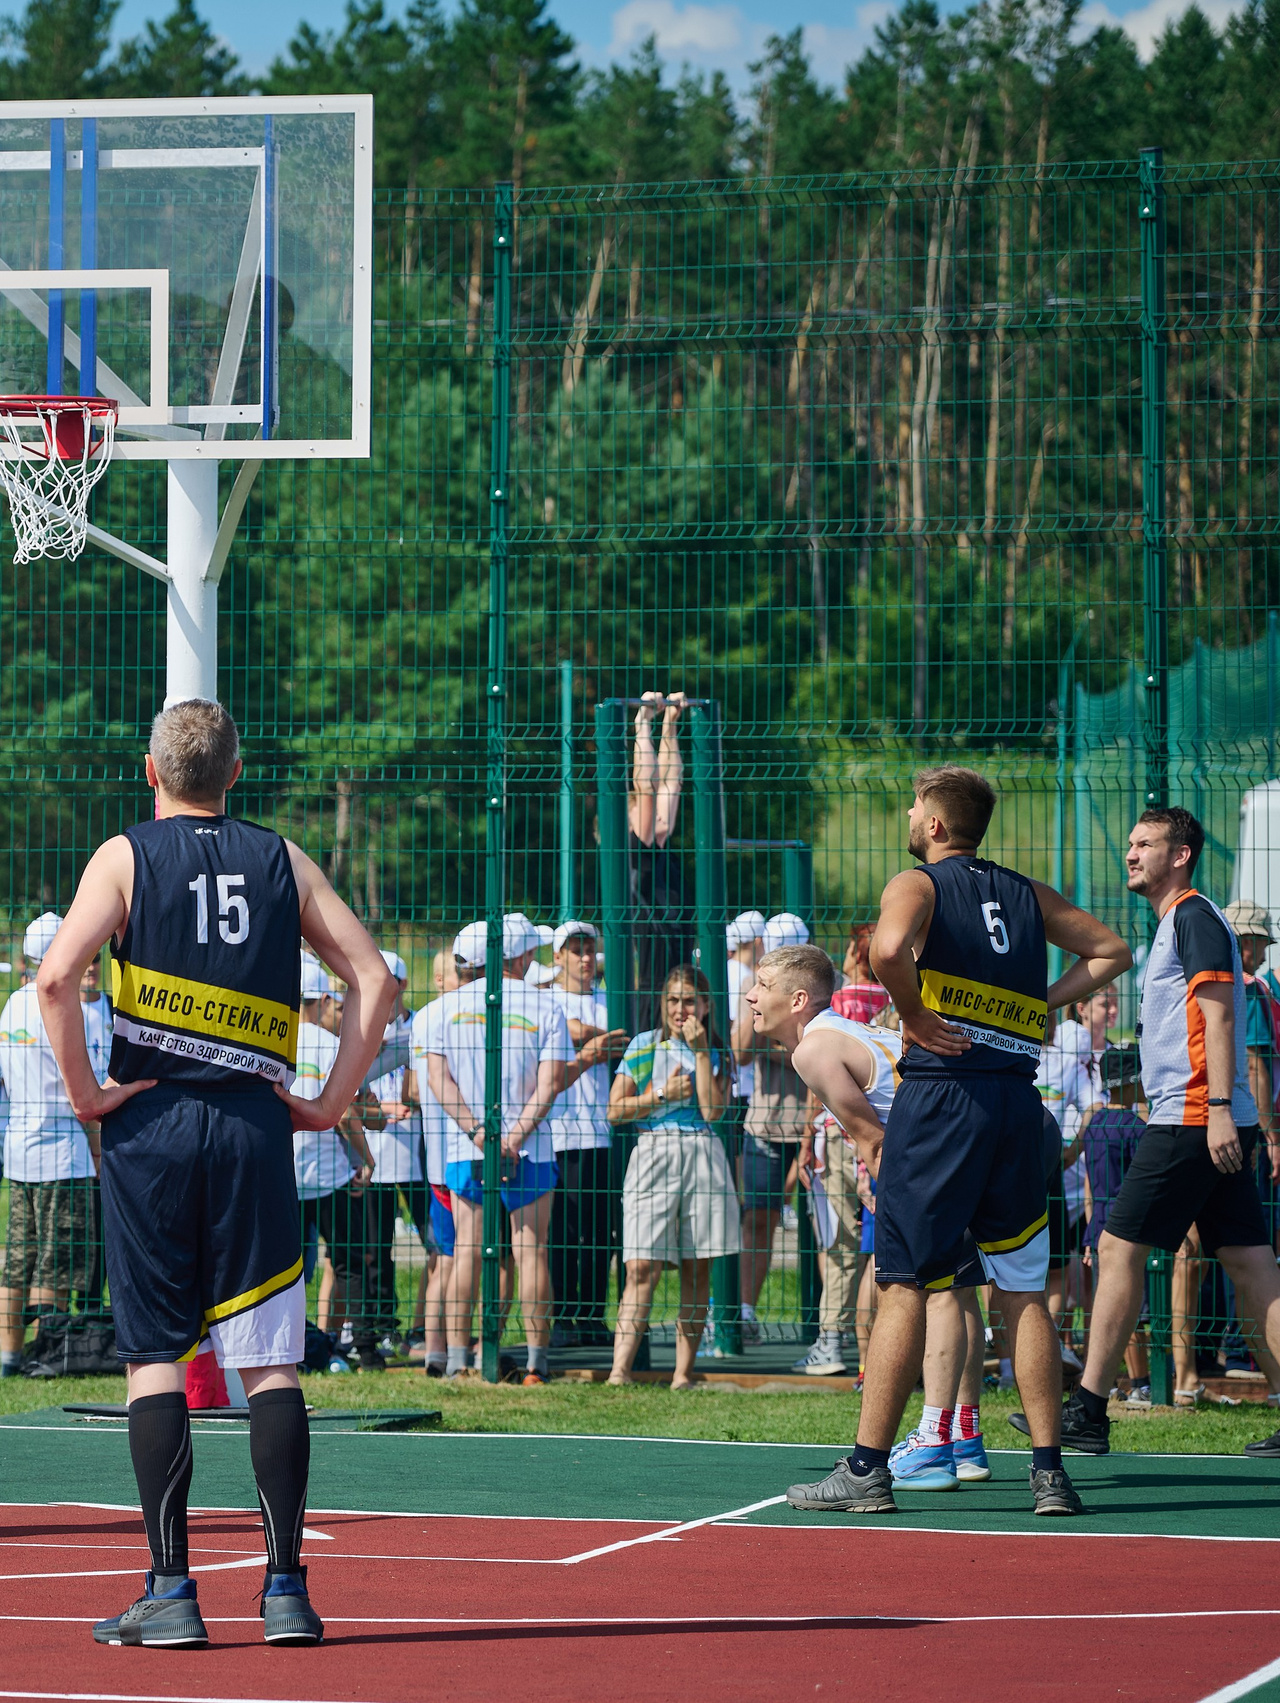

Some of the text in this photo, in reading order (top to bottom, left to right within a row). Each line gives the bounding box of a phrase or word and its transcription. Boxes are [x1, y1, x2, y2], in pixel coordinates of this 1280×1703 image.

[188, 873, 250, 945] 15
[980, 901, 1010, 955] 5
[137, 984, 289, 1041] МЯСО-СТЕЙК.РФ
[939, 985, 1047, 1030] МЯСО-СТЕЙК.РФ
[138, 1030, 281, 1078] КАЧЕСТВО ЗДОРОВОЙ ЖИЗНИ
[1016, 1042, 1041, 1058] ЖИЗН
